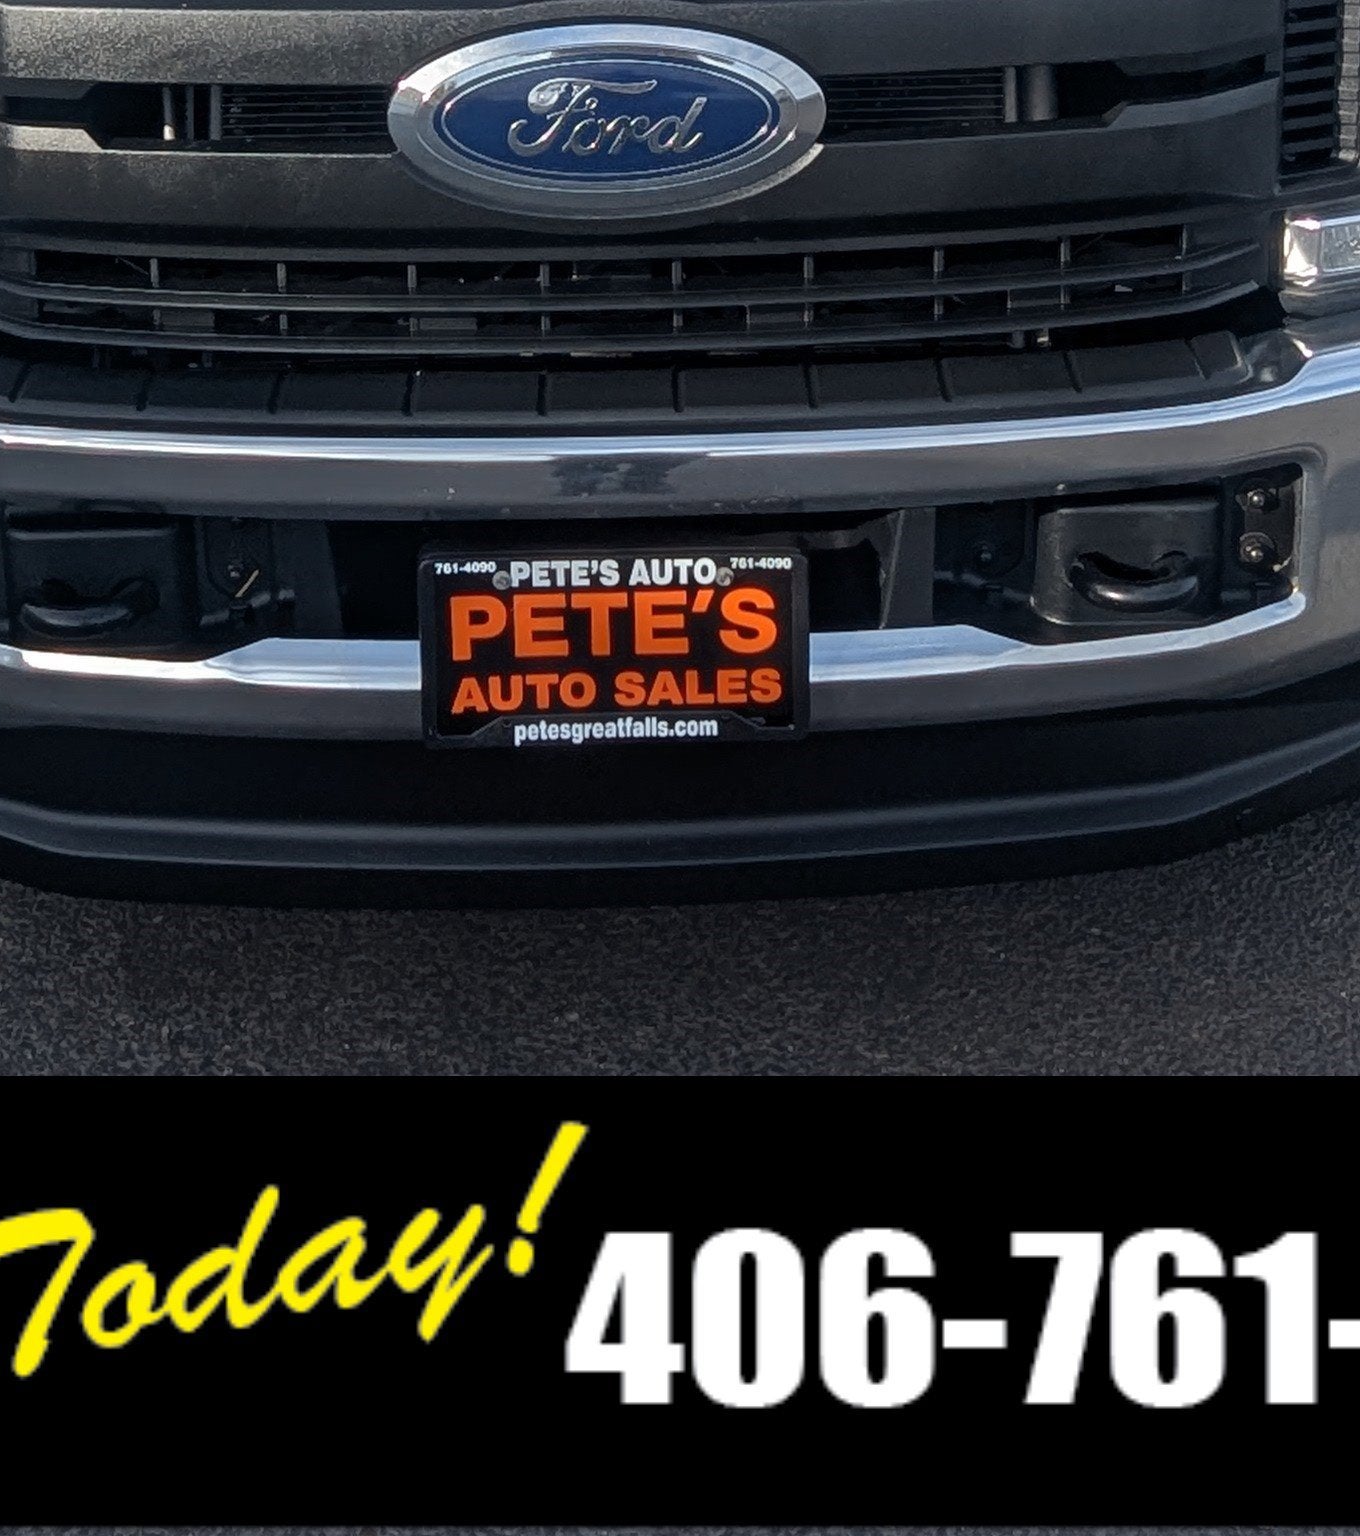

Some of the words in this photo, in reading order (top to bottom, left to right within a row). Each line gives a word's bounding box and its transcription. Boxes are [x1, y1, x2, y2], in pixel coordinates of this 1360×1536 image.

[507, 76, 709, 158] Ford
[435, 562, 497, 575] 761-4090
[509, 560, 620, 588] PETE'S
[628, 557, 717, 586] AUTO
[729, 557, 792, 571] 761-4090
[450, 588, 778, 662] PETE'S
[451, 671, 597, 715] AUTO
[613, 667, 783, 708] SALES
[513, 716, 719, 748] petesgreatfalls.com
